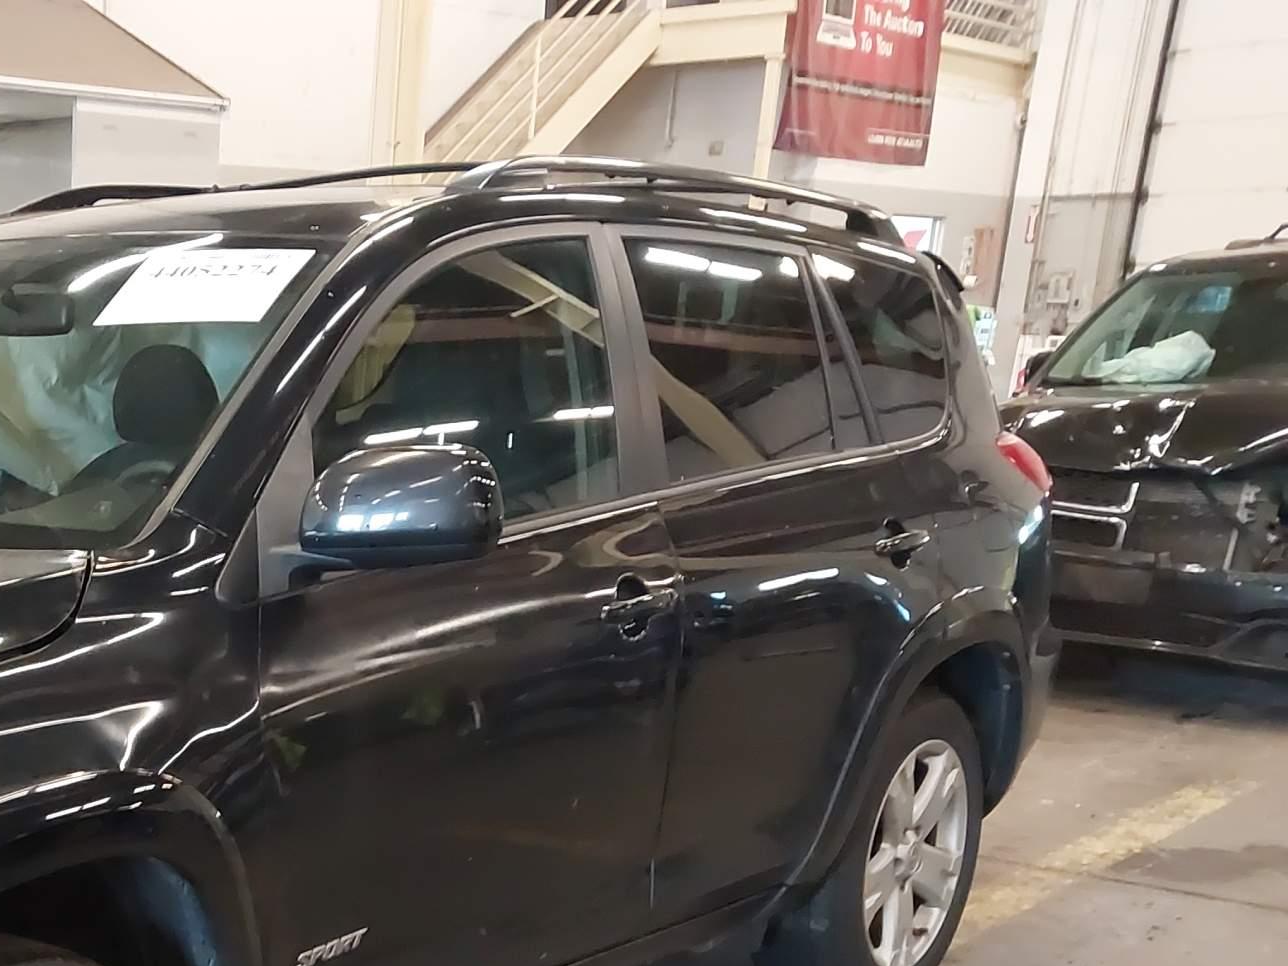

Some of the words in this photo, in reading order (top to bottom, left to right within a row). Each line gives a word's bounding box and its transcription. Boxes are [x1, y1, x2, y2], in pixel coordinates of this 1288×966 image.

[864, 4, 882, 27] The
[860, 31, 873, 53] To
[875, 33, 894, 57] You
